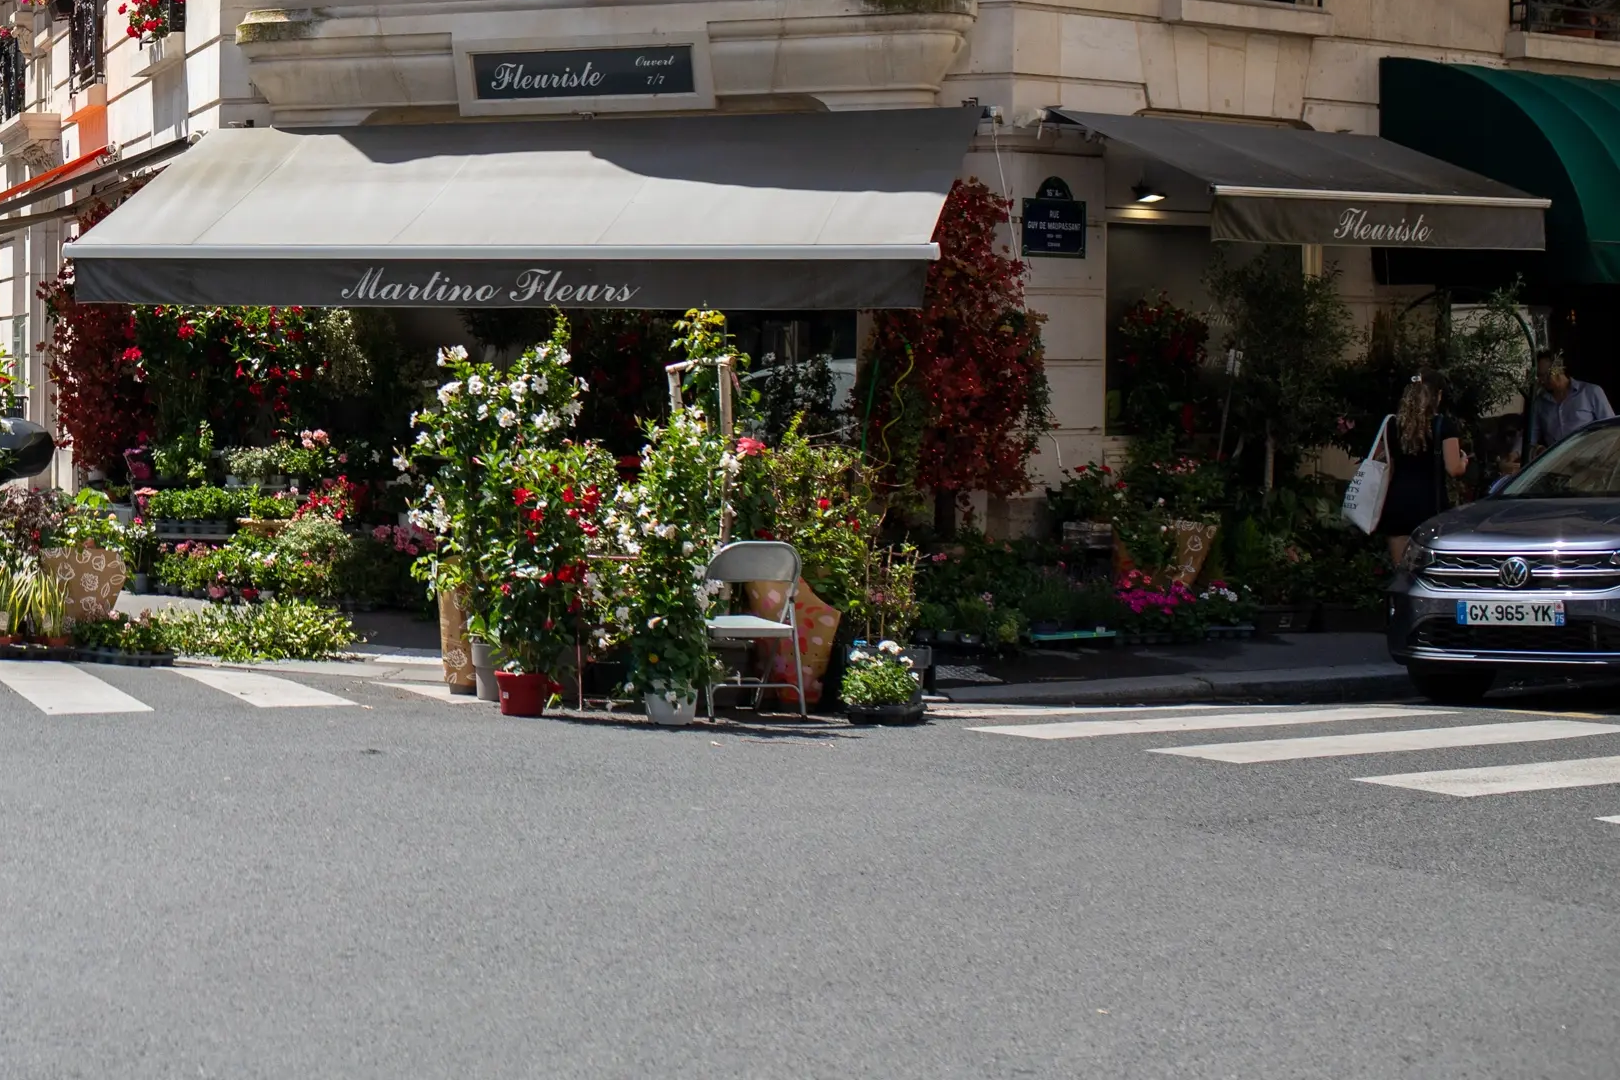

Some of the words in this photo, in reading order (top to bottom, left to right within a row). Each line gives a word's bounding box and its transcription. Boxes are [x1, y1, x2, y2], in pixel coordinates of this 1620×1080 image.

[635, 55, 676, 67] Ouvert
[491, 61, 606, 91] Fleuriste
[646, 73, 666, 85] 7/7
[1049, 209, 1060, 219] RUE
[1027, 220, 1038, 229] GUY
[1039, 221, 1046, 230] DE
[1047, 222, 1081, 231] MAUPASSANT
[1333, 207, 1434, 242] Fleuriste
[341, 267, 502, 302] Martino
[509, 268, 641, 302] Fleurs
[1555, 614, 1565, 623] 75
